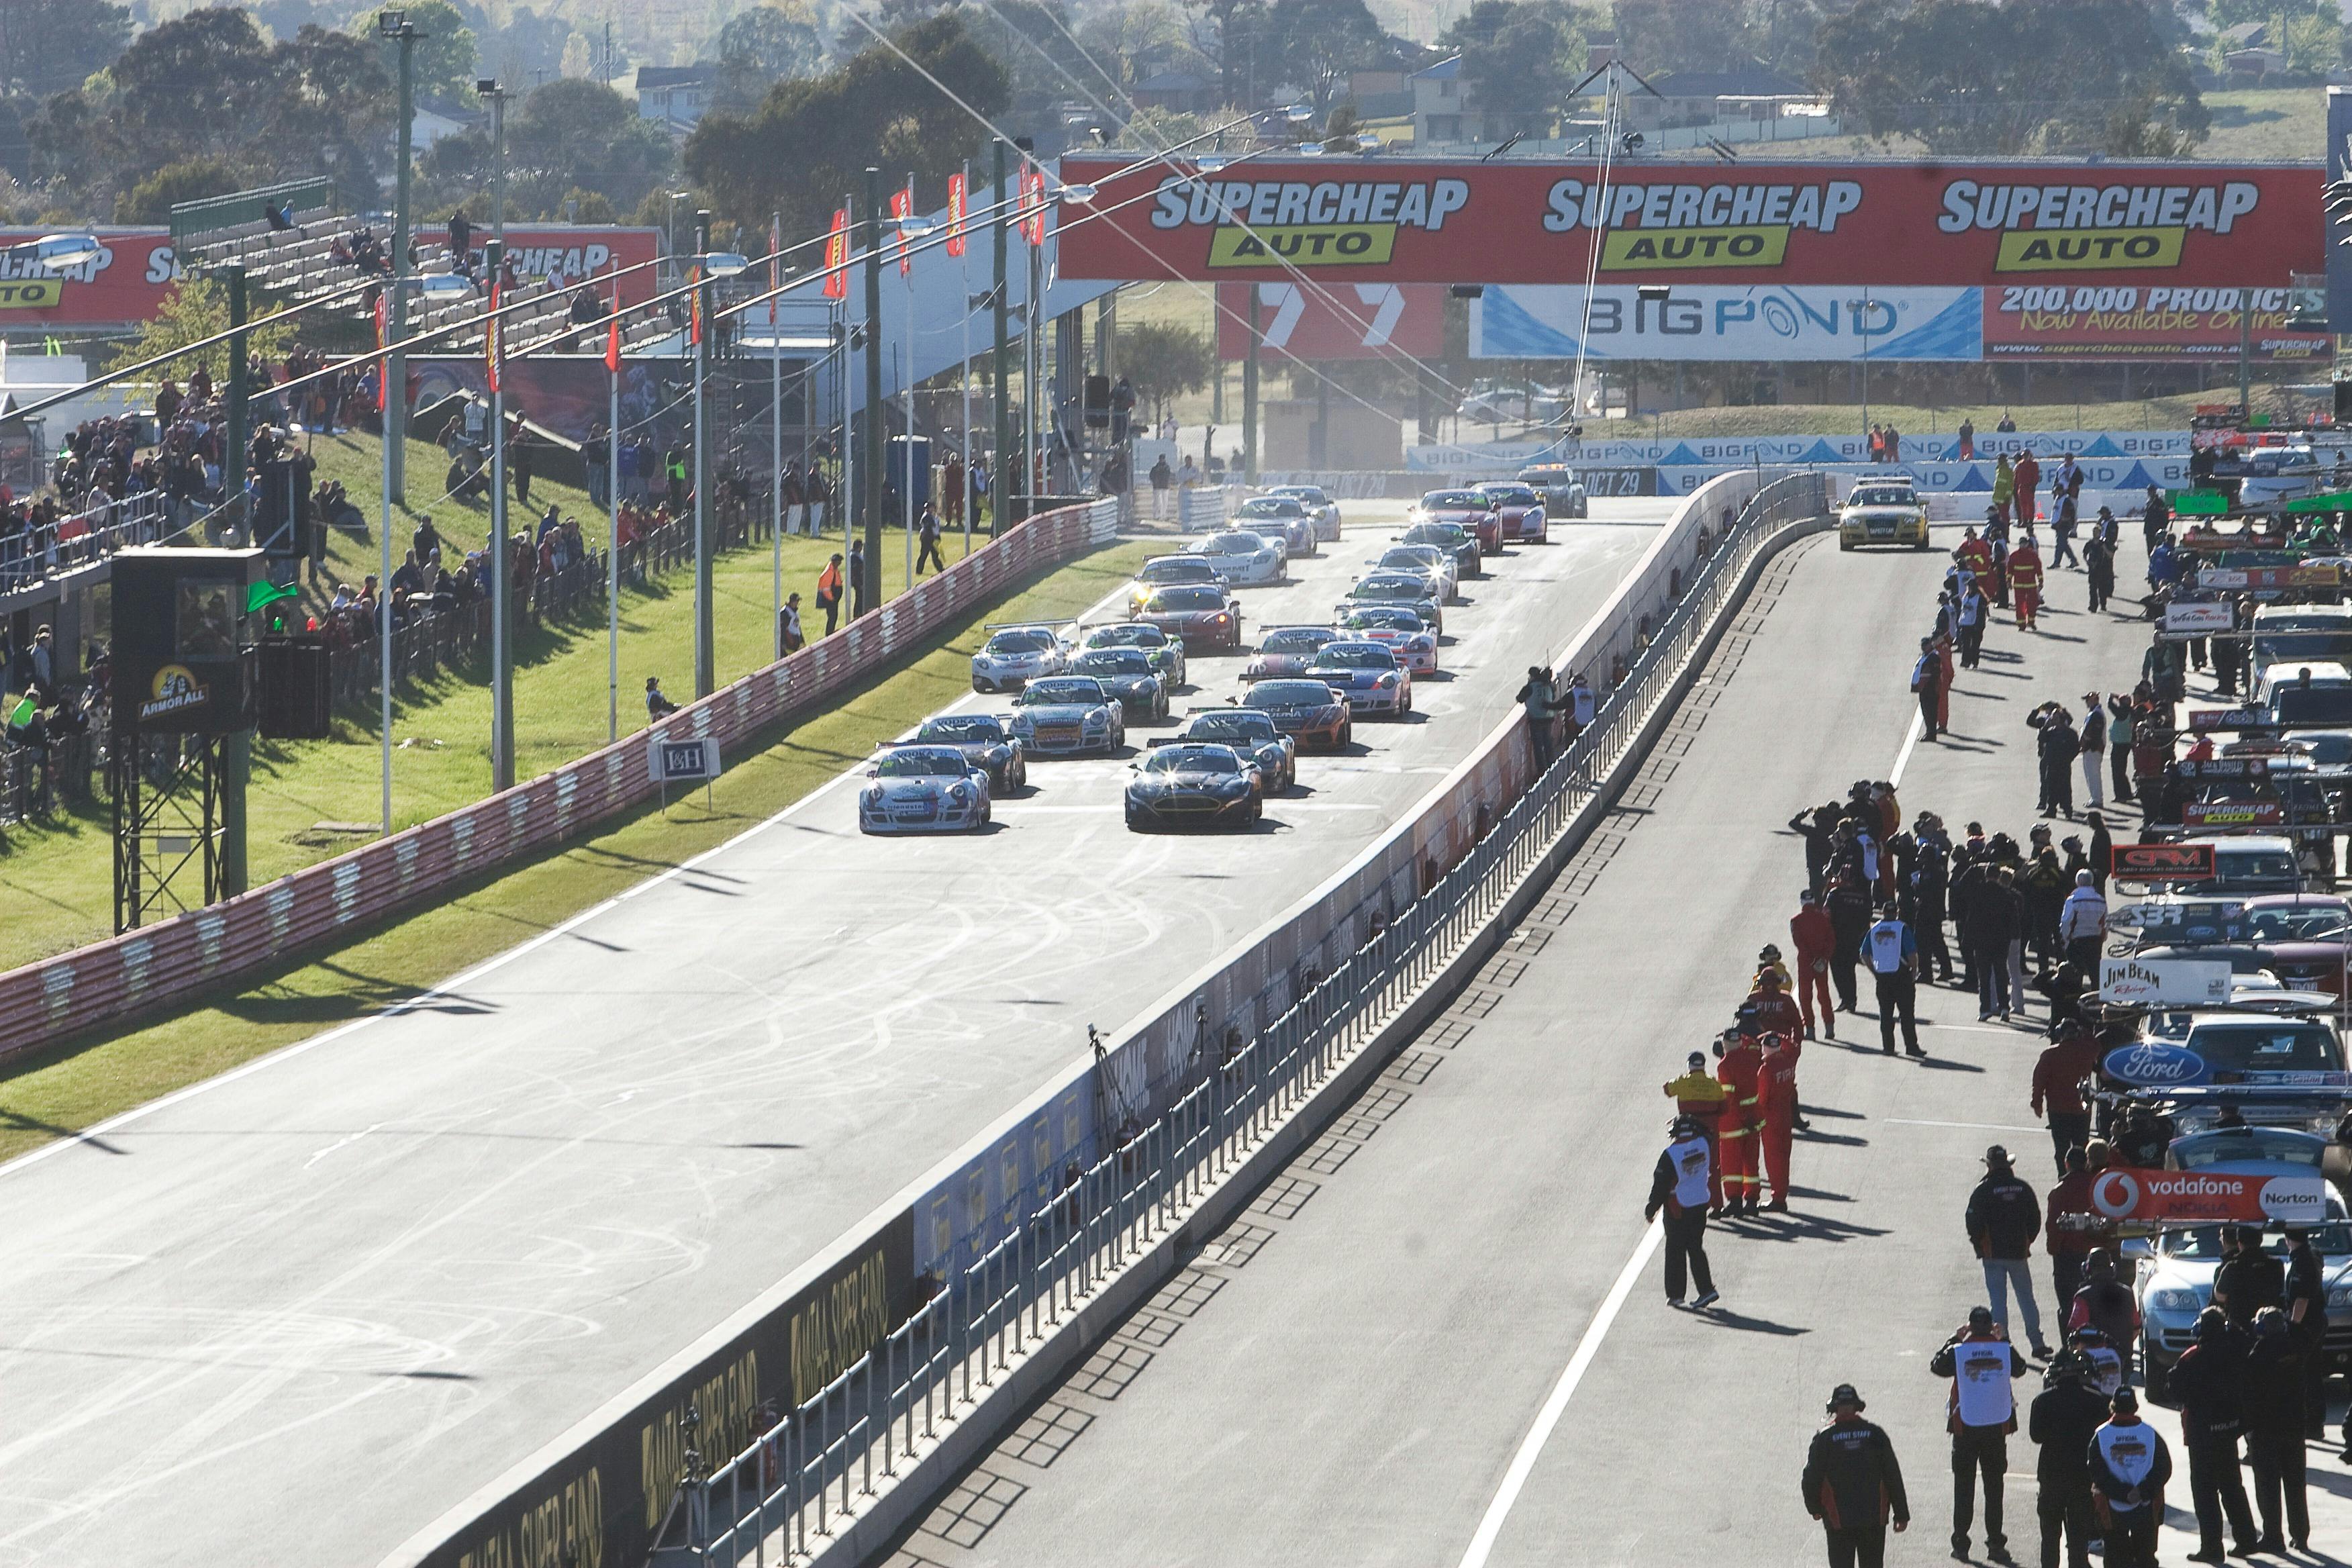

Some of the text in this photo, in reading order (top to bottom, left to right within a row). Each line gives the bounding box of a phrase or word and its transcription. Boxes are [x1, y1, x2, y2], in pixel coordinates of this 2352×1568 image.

[1150, 175, 1469, 230] SUPERCHEAP
[1543, 179, 1863, 233] SUPERCHEAP
[1938, 179, 2259, 234] SUPERCHEAP
[1232, 231, 1372, 257] AUTO
[1624, 234, 1765, 260] AUTO
[2018, 236, 2161, 262] AUTO
[2000, 286, 2138, 314] 200,000
[2020, 309, 2077, 330] Now
[2084, 306, 2200, 330] Available
[1618, 471, 1639, 493] 29
[142, 689, 205, 718] ARMOR ALL
[2188, 804, 2275, 816] SUPERCHEAP
[2104, 963, 2161, 989] JIM BEAM
[2123, 1042, 2184, 1079] Ford
[2148, 1177, 2243, 1195] vodafone
[2265, 1193, 2318, 1205] Norton
[2169, 1202, 2228, 1215] NOKIA
